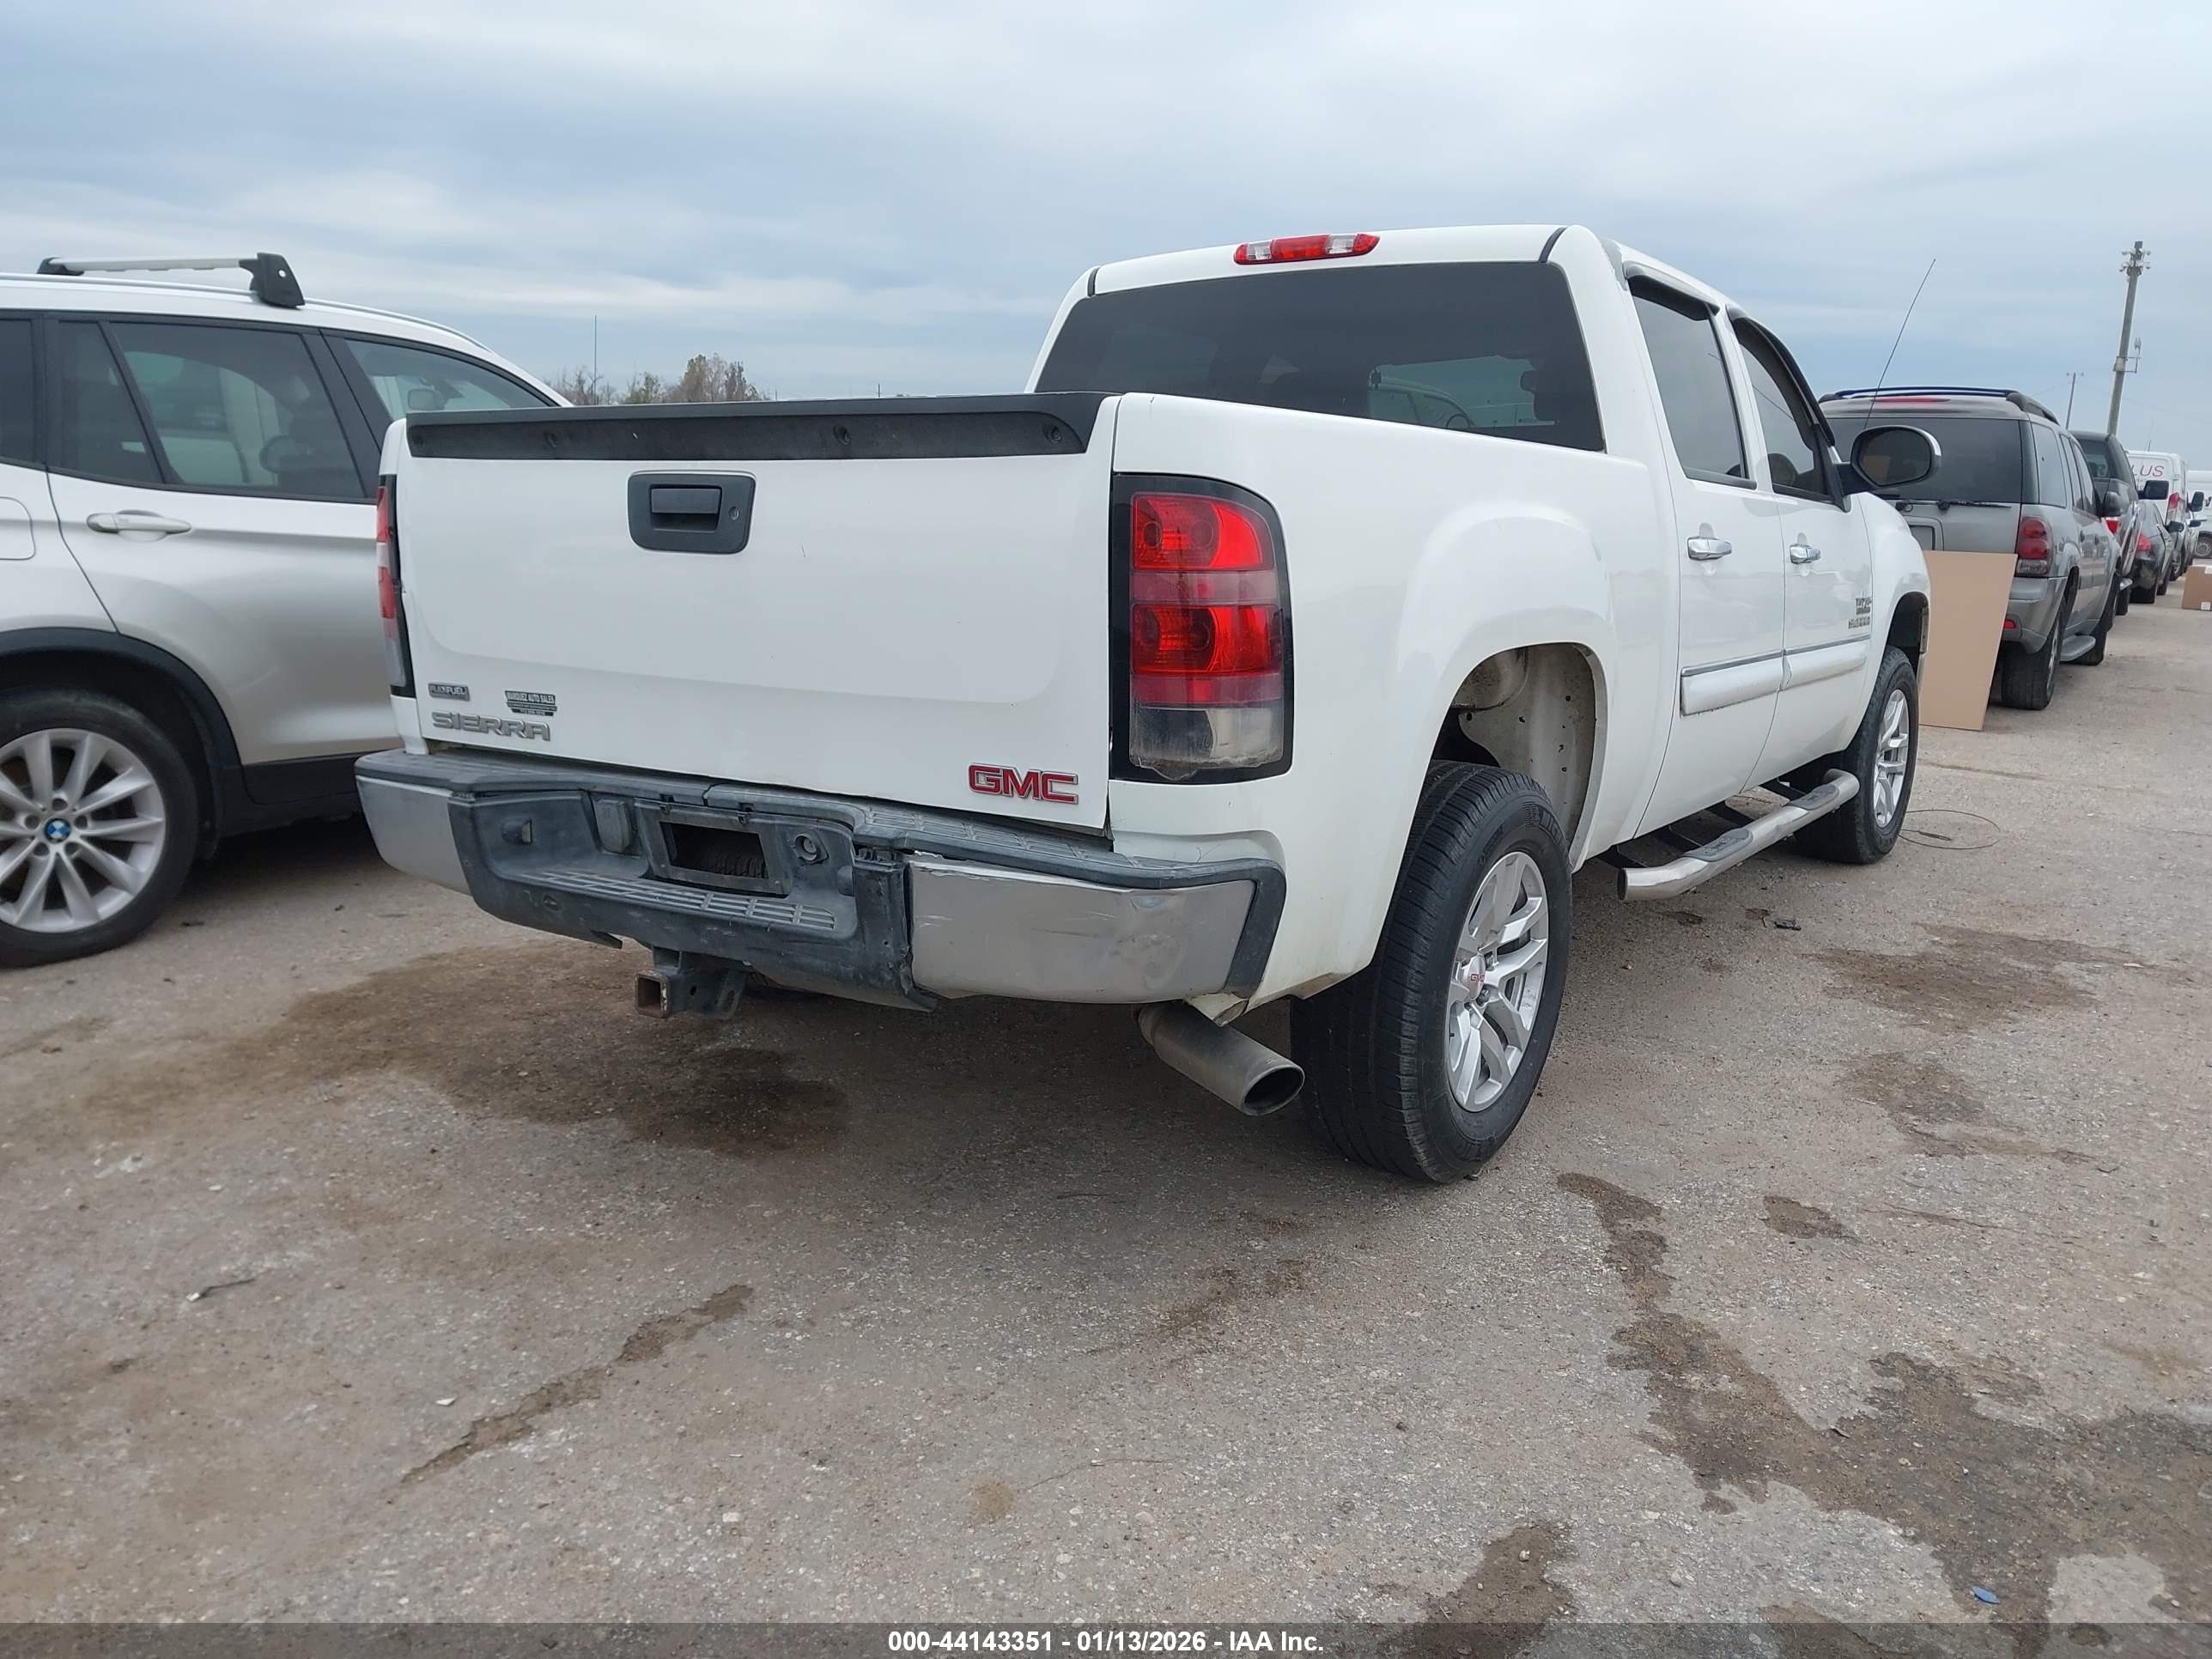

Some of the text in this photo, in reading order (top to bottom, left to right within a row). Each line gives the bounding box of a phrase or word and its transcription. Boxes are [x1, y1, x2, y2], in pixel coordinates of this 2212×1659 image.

[528, 693, 540, 703] AUTO
[540, 694, 556, 705] SALES
[431, 711, 551, 742] SIERRA
[969, 763, 1079, 805] GMC
